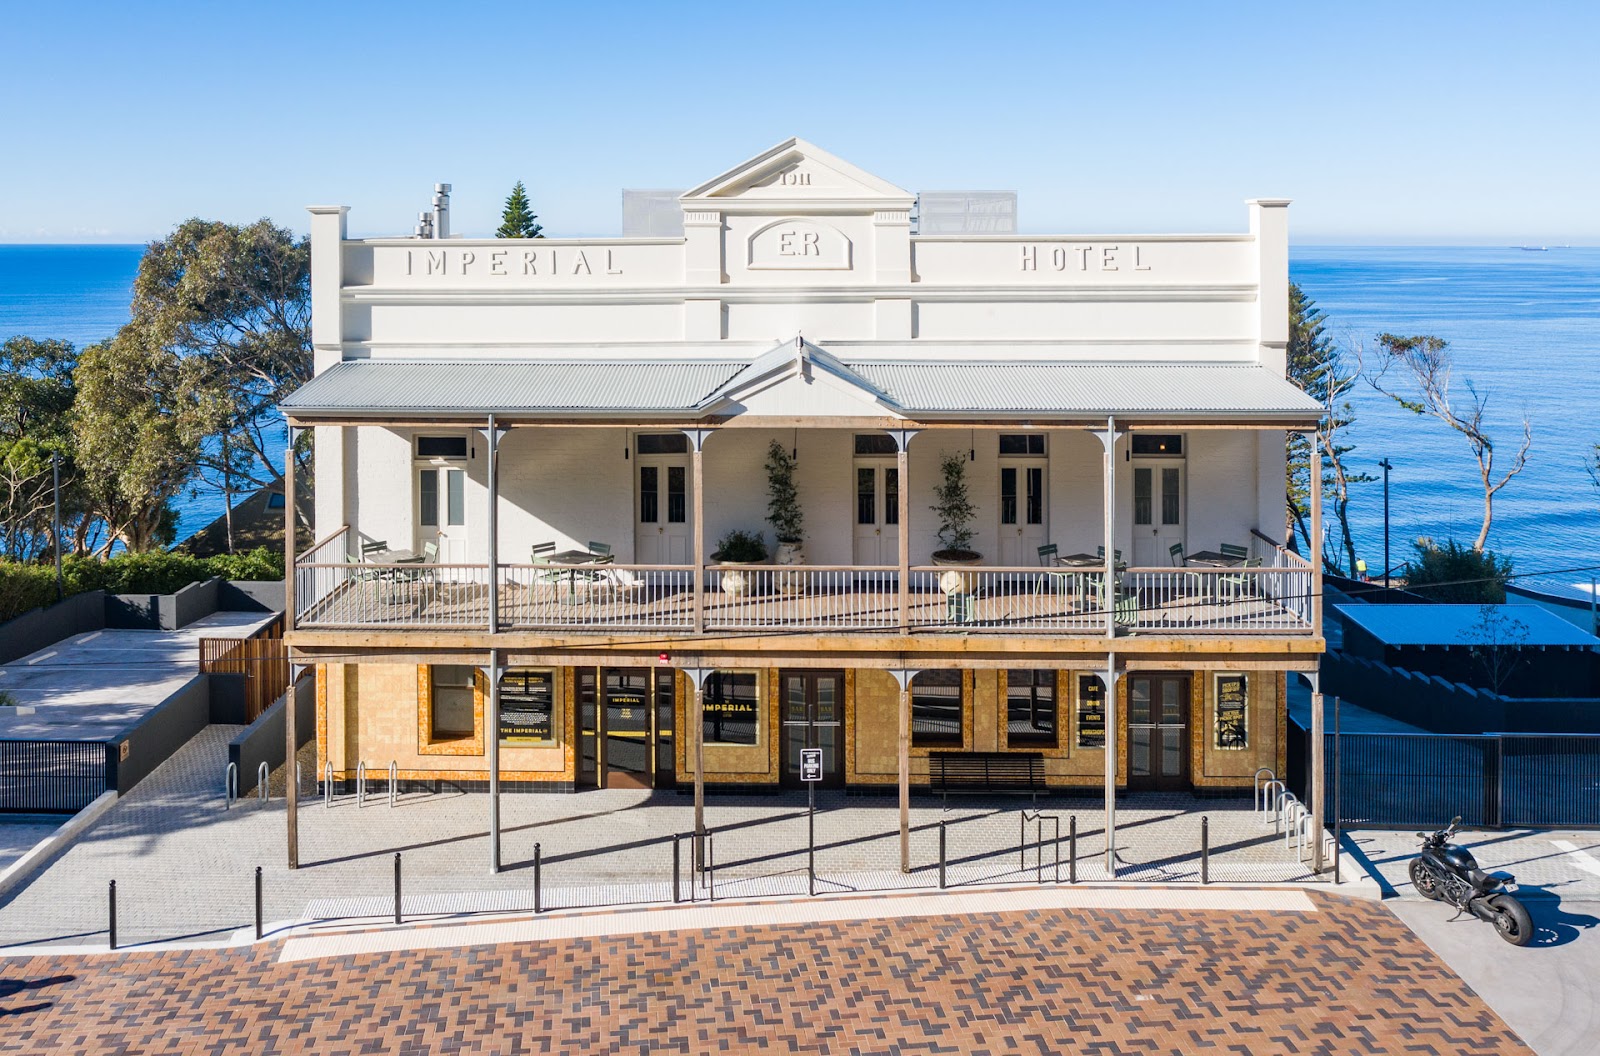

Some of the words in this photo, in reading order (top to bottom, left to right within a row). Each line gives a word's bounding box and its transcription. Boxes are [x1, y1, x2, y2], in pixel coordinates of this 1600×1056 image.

[779, 172, 811, 186] 1911
[405, 248, 623, 275] IMPERIAL
[1019, 244, 1151, 272] HOTEL
[702, 704, 752, 712] IMPERIAL
